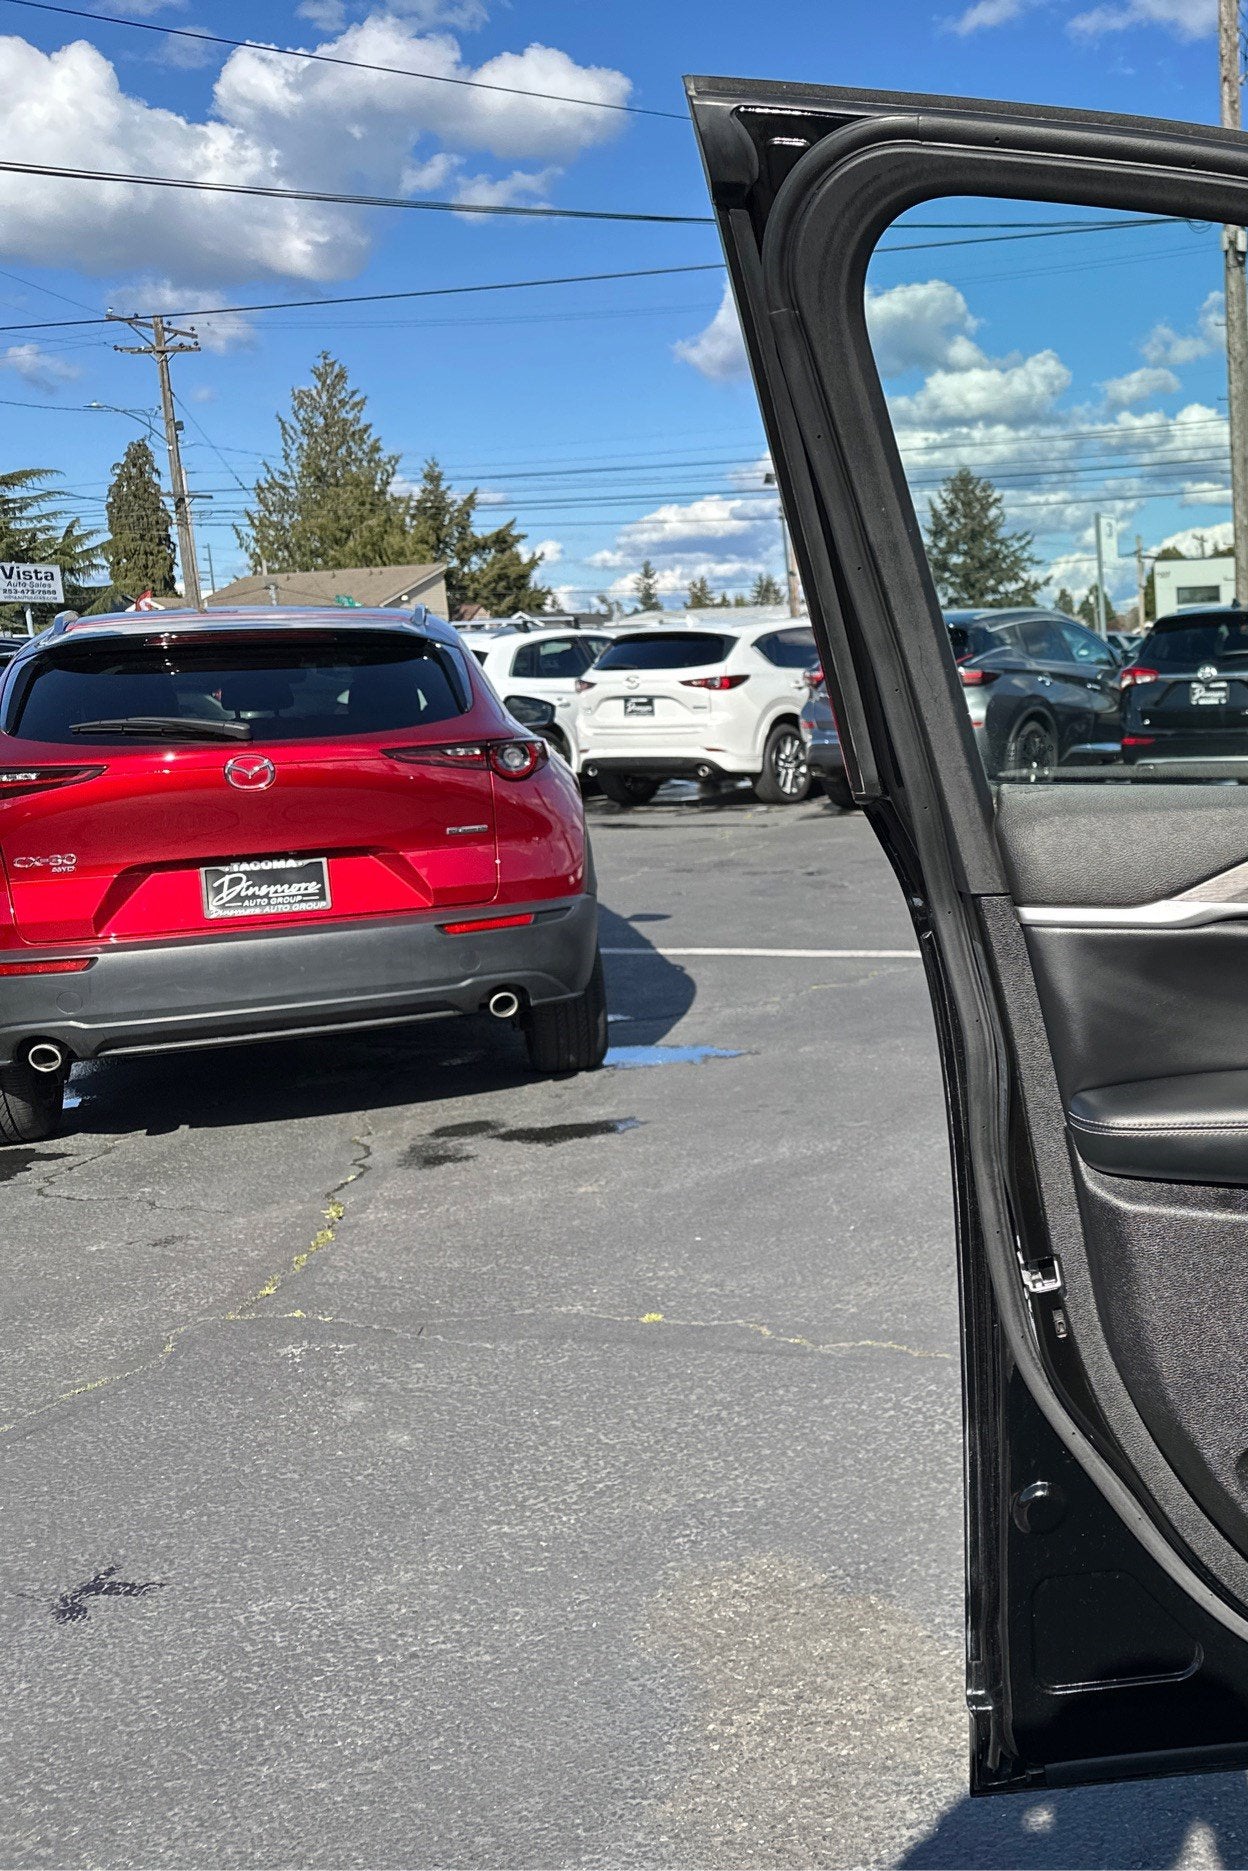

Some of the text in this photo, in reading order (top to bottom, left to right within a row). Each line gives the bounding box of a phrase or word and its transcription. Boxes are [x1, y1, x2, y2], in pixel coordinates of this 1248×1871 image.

[0, 565, 54, 581] Vista
[29, 581, 52, 589] Sales
[13, 853, 77, 868] CX-30
[231, 859, 297, 872] TACOMA
[243, 895, 303, 907] AUTO GROUP
[263, 903, 292, 914] AUTO
[292, 901, 327, 911] GROUP
